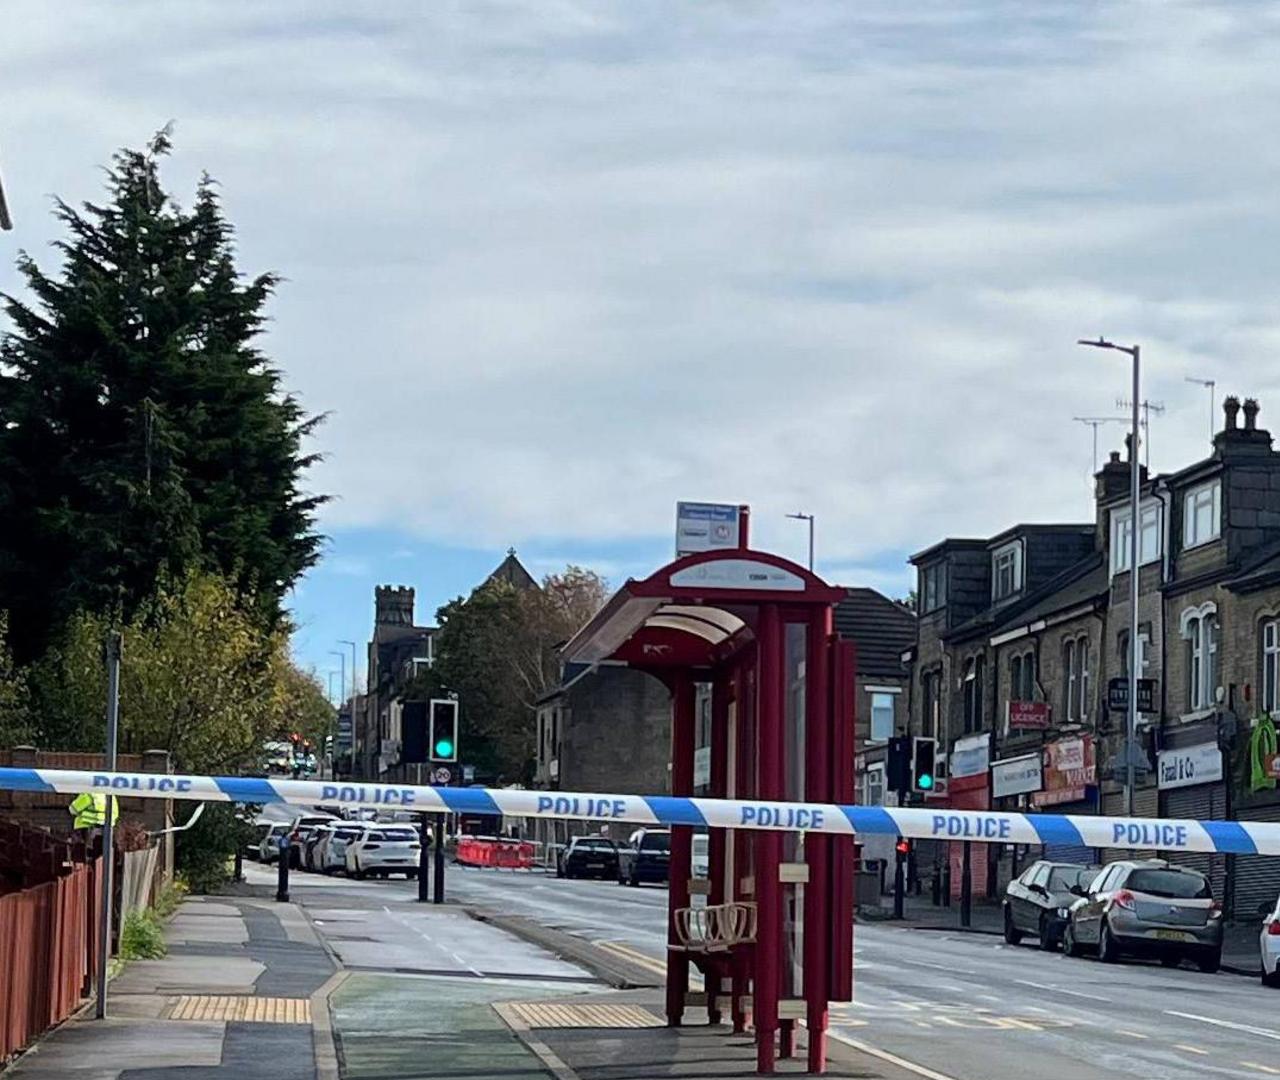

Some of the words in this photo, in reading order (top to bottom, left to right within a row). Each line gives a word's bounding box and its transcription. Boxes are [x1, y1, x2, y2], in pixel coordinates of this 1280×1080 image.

[93, 775, 191, 793] POLICE
[322, 786, 415, 806] POLICE
[538, 797, 626, 816] POLICE
[741, 806, 823, 829] POLICE
[932, 816, 1010, 838] POLICE
[1113, 823, 1186, 847] POLICE
